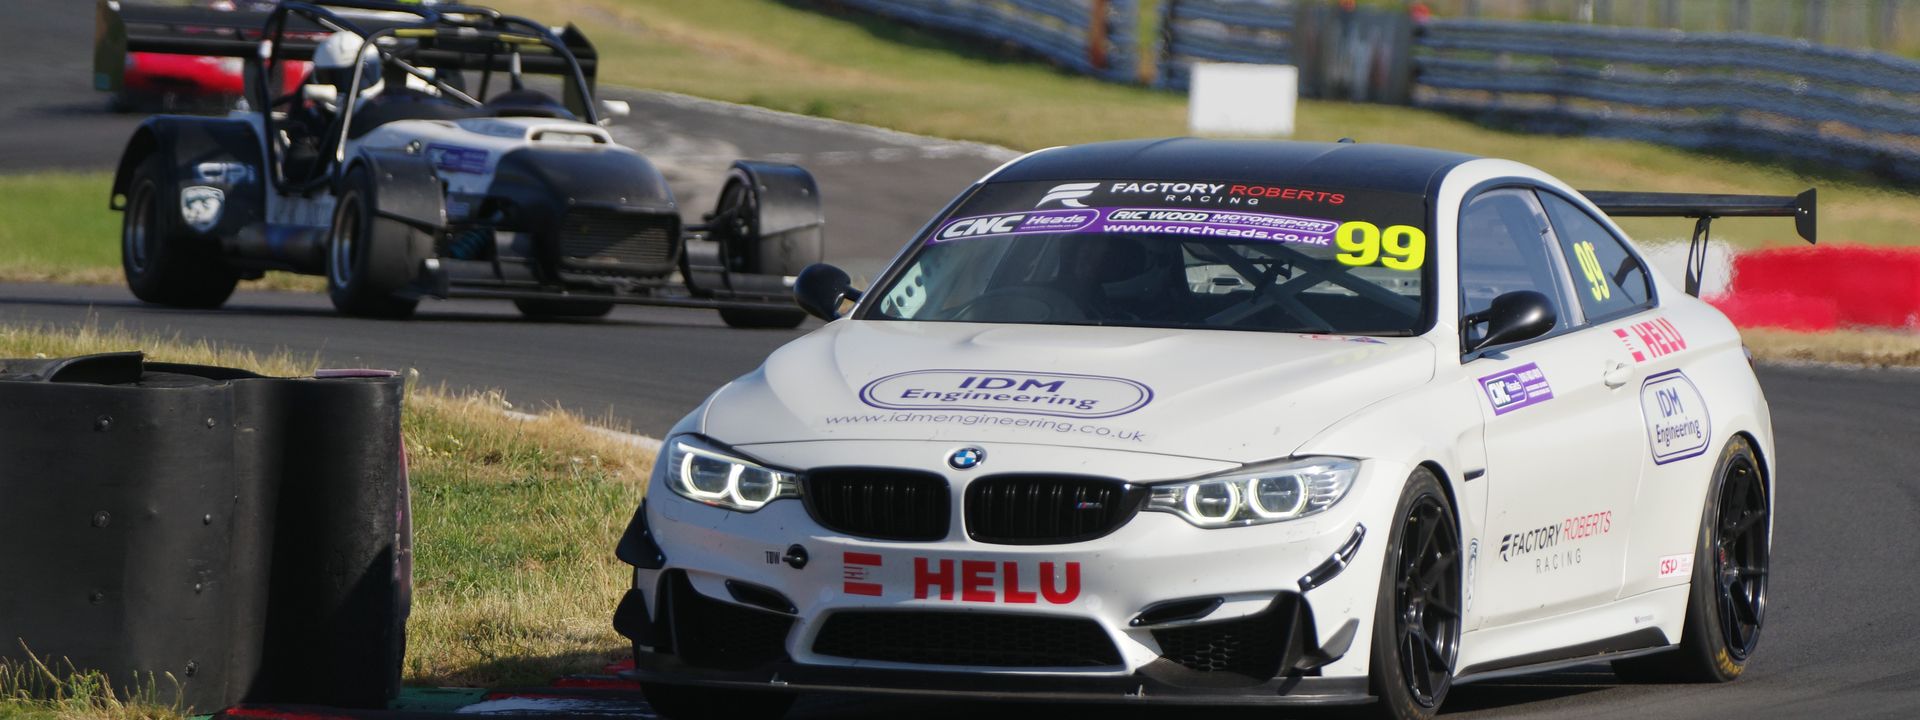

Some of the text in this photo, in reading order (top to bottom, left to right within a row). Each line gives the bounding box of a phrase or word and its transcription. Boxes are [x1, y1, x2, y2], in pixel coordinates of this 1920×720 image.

[1110, 183, 1345, 205] FACTORY ROBERTS
[1165, 194, 1259, 205] RACING
[943, 214, 1087, 238] CNC Heads
[1113, 210, 1332, 230] RIC WOOD MOTORSPORT
[1103, 224, 1332, 246] www.cncheads.co.uk
[1335, 221, 1426, 271] 99
[1573, 240, 1610, 301] 99
[1630, 317, 1687, 358] HELU
[958, 376, 1067, 393] IDM
[900, 388, 1100, 410] Engineering
[1655, 386, 1684, 418] IDM
[825, 411, 1147, 442] www.idmengineering.co.uk
[1655, 416, 1702, 447] Engineering
[1511, 510, 1612, 557] FACTORY ROBERTS
[1536, 548, 1582, 574] RACING
[914, 557, 1081, 605] HELU
